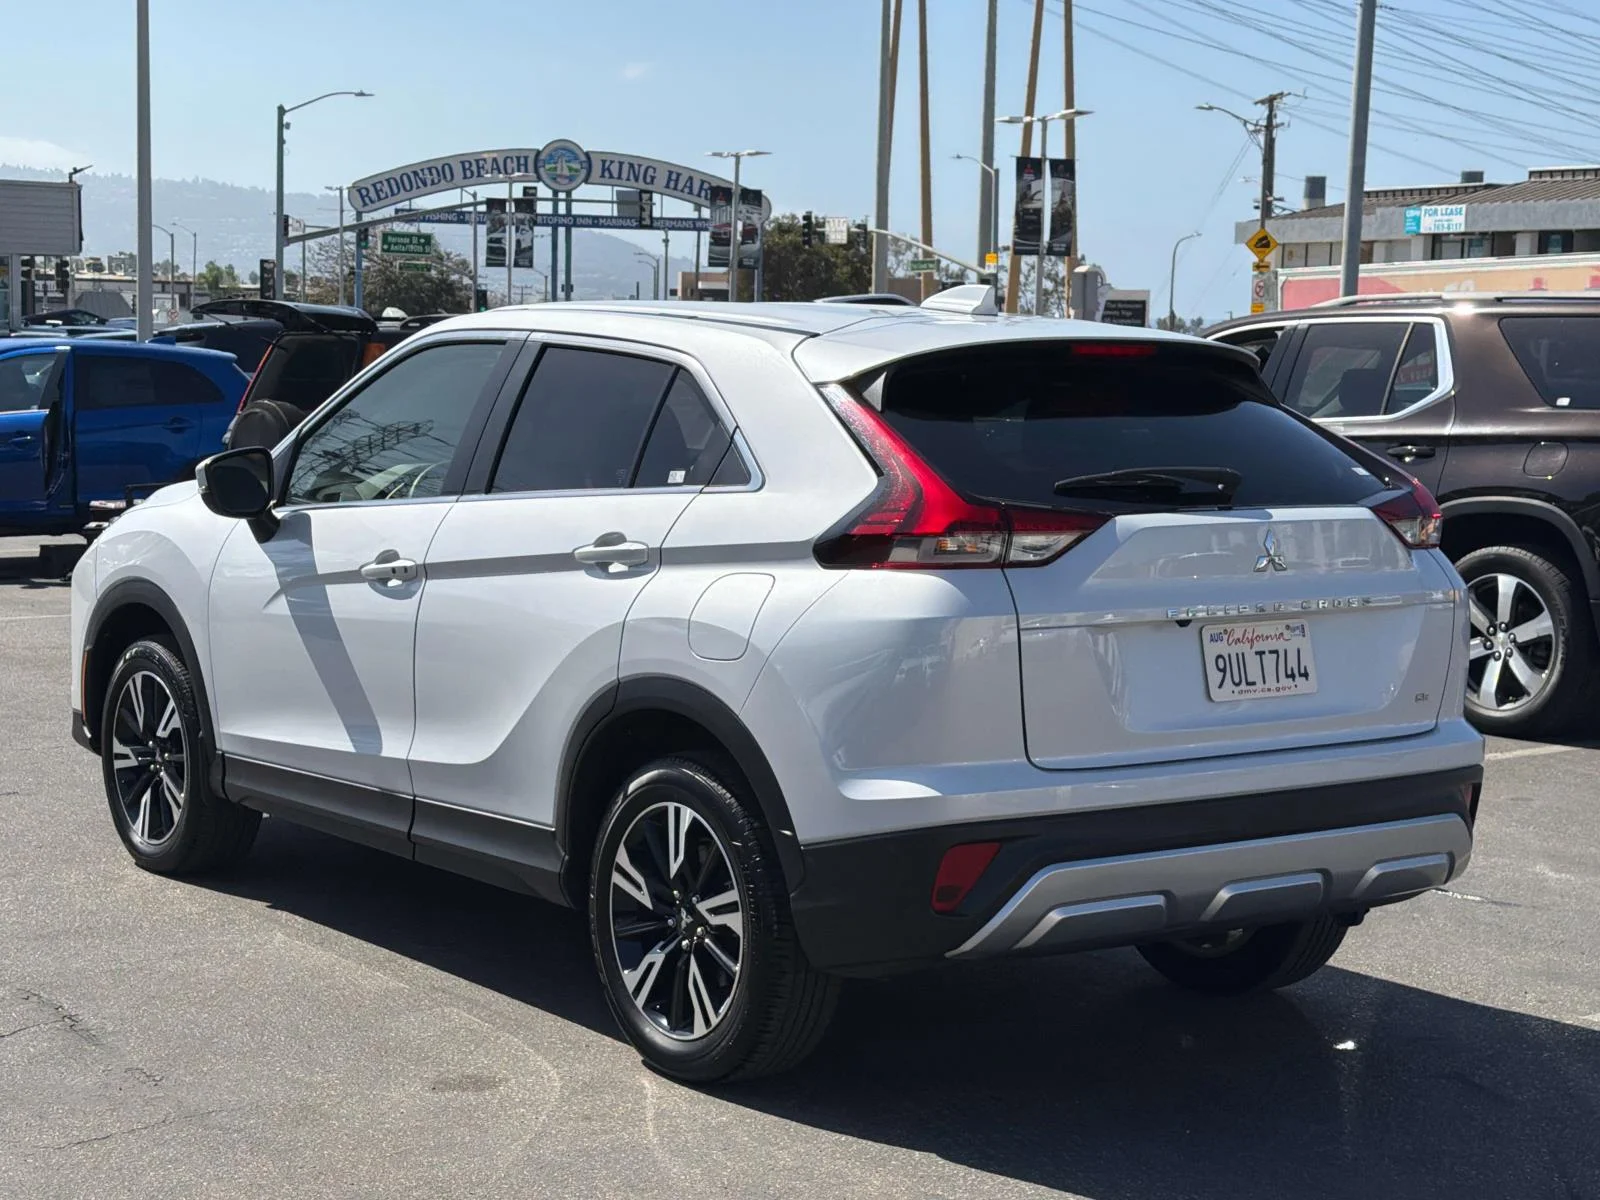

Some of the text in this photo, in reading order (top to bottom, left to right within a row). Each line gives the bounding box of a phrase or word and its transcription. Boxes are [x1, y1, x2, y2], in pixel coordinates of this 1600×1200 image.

[357, 155, 712, 207] REDONDO BEACH KING HAR
[1424, 207, 1439, 217] FOR
[1440, 206, 1463, 217] LEASE
[1209, 632, 1224, 643] AUG
[1226, 628, 1291, 649] California
[1215, 647, 1309, 689] 9ULT744
[1237, 685, 1293, 695] dmv.ca.gov
